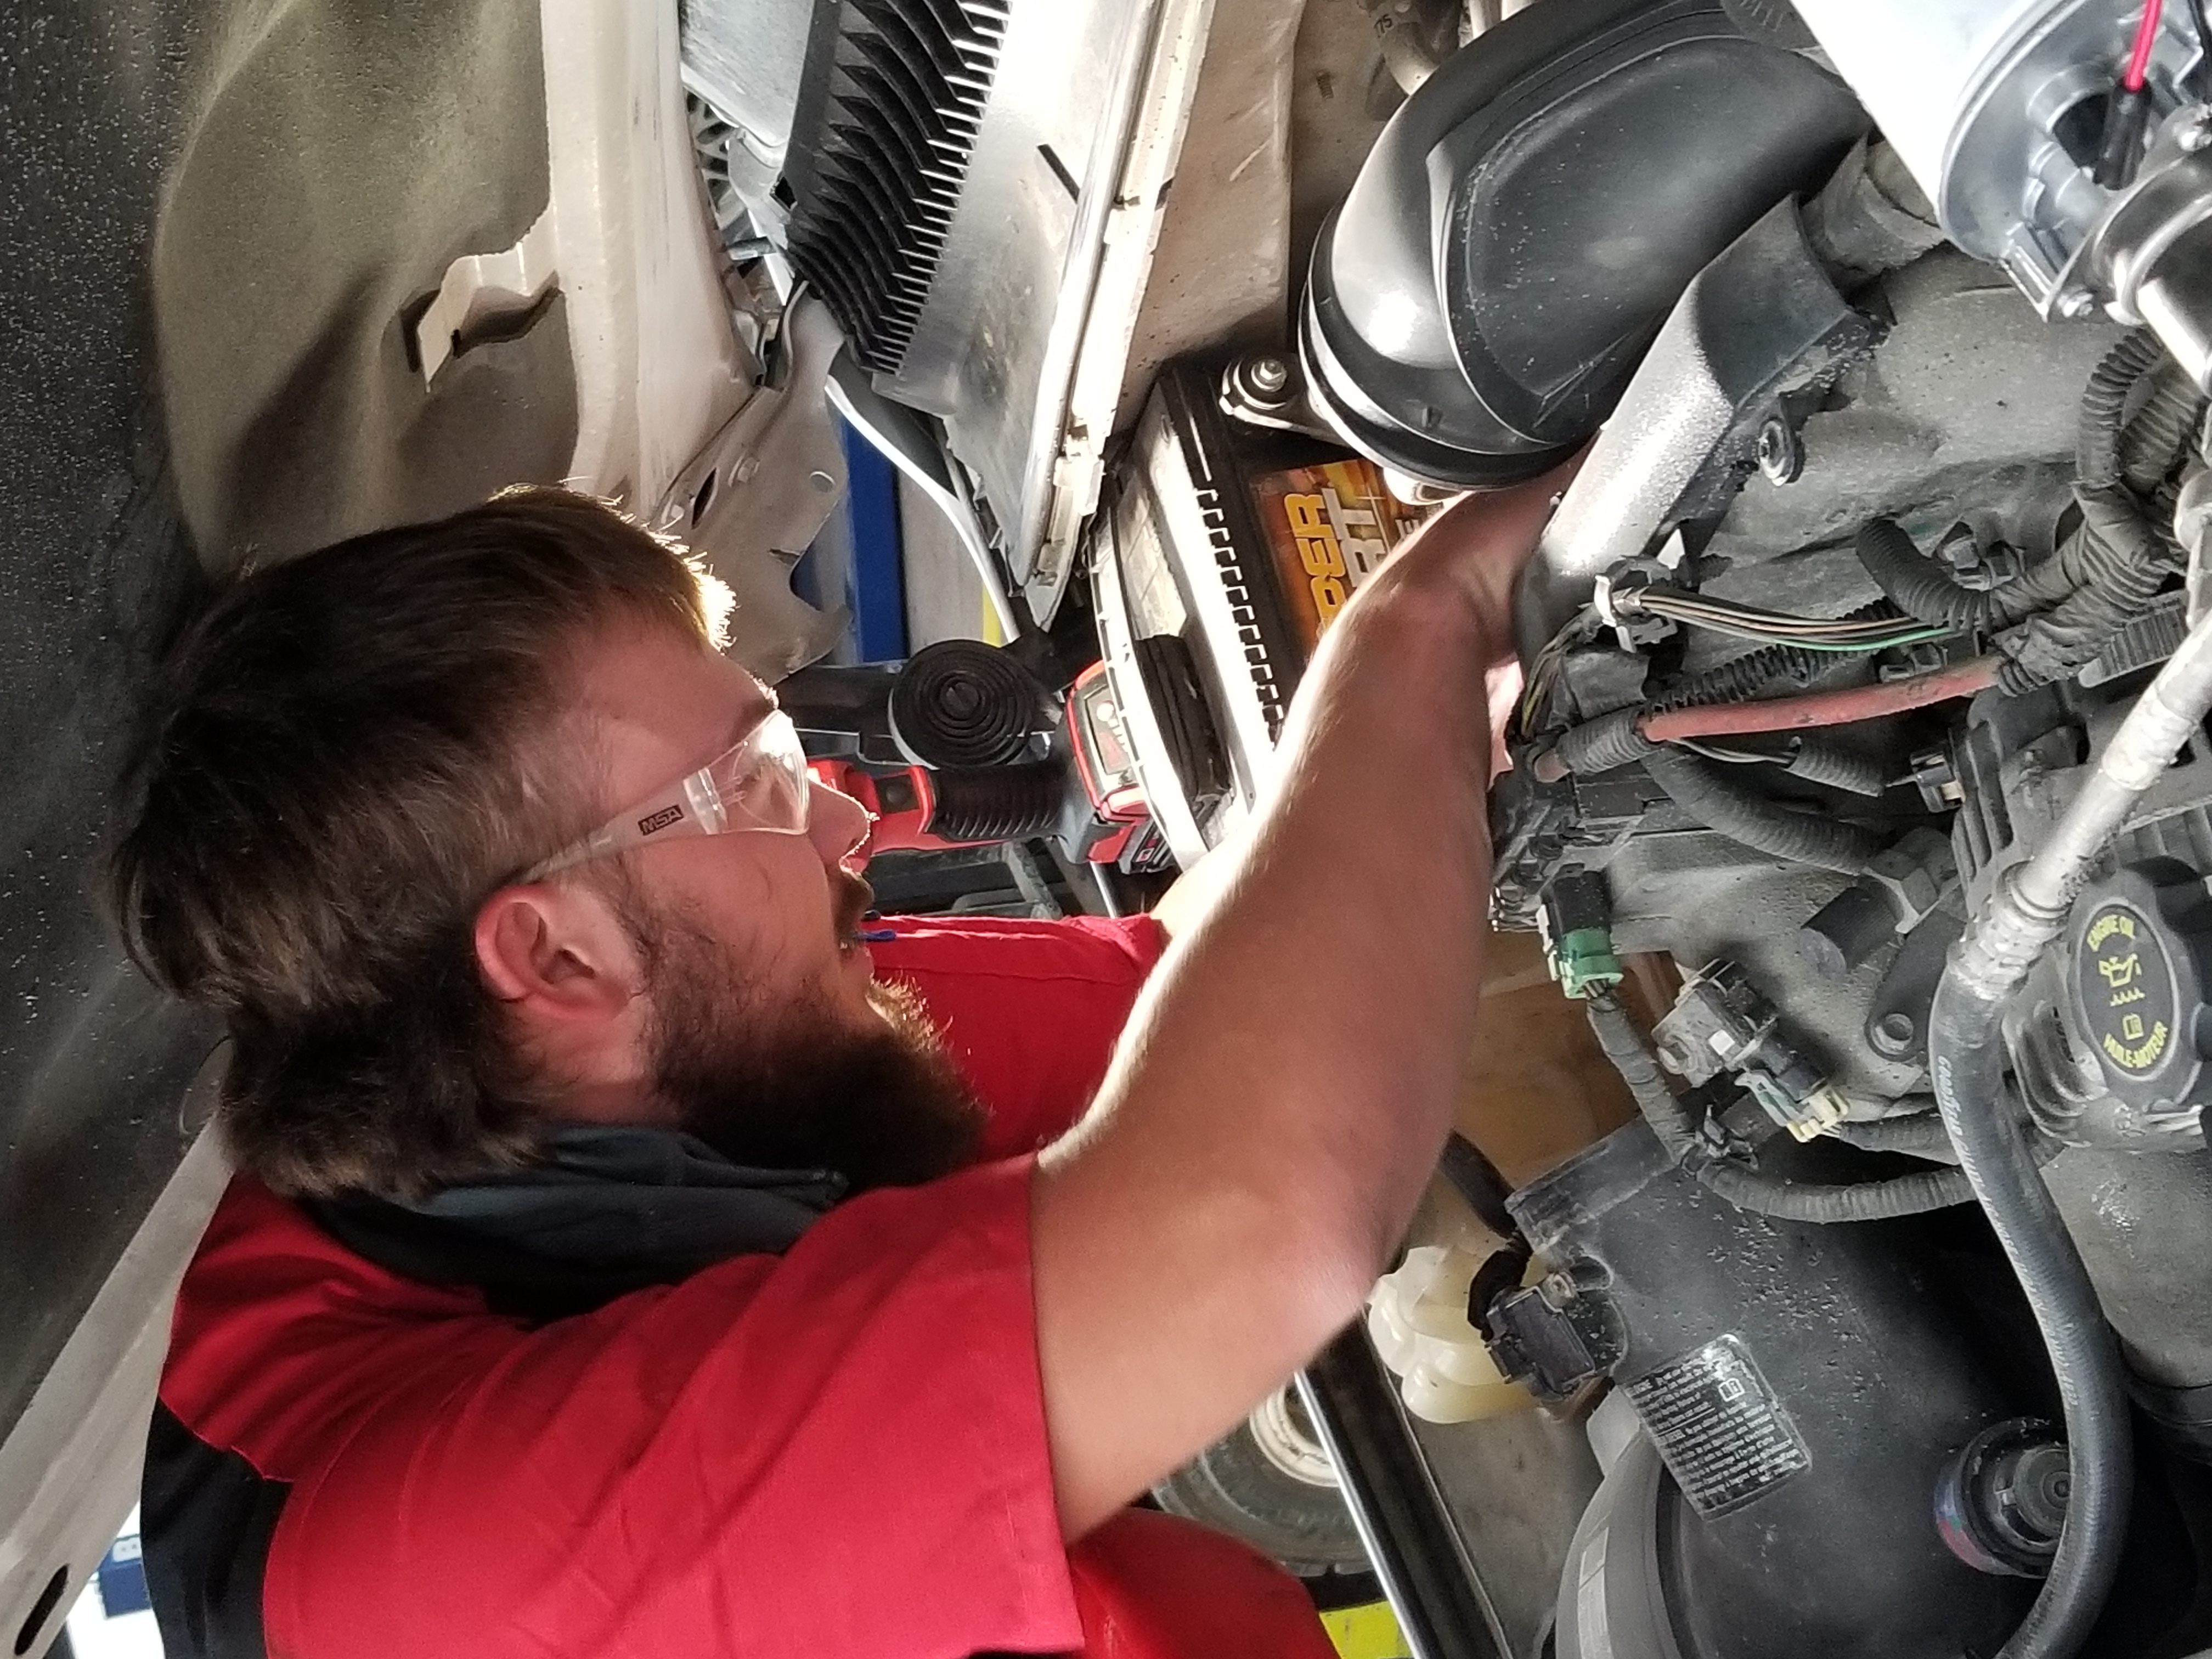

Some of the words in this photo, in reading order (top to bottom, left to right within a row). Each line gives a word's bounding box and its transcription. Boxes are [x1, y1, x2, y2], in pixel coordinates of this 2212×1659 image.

[1284, 494, 1346, 628] PER
[642, 806, 682, 833] MSA
[2087, 915, 2119, 952] ENGINE
